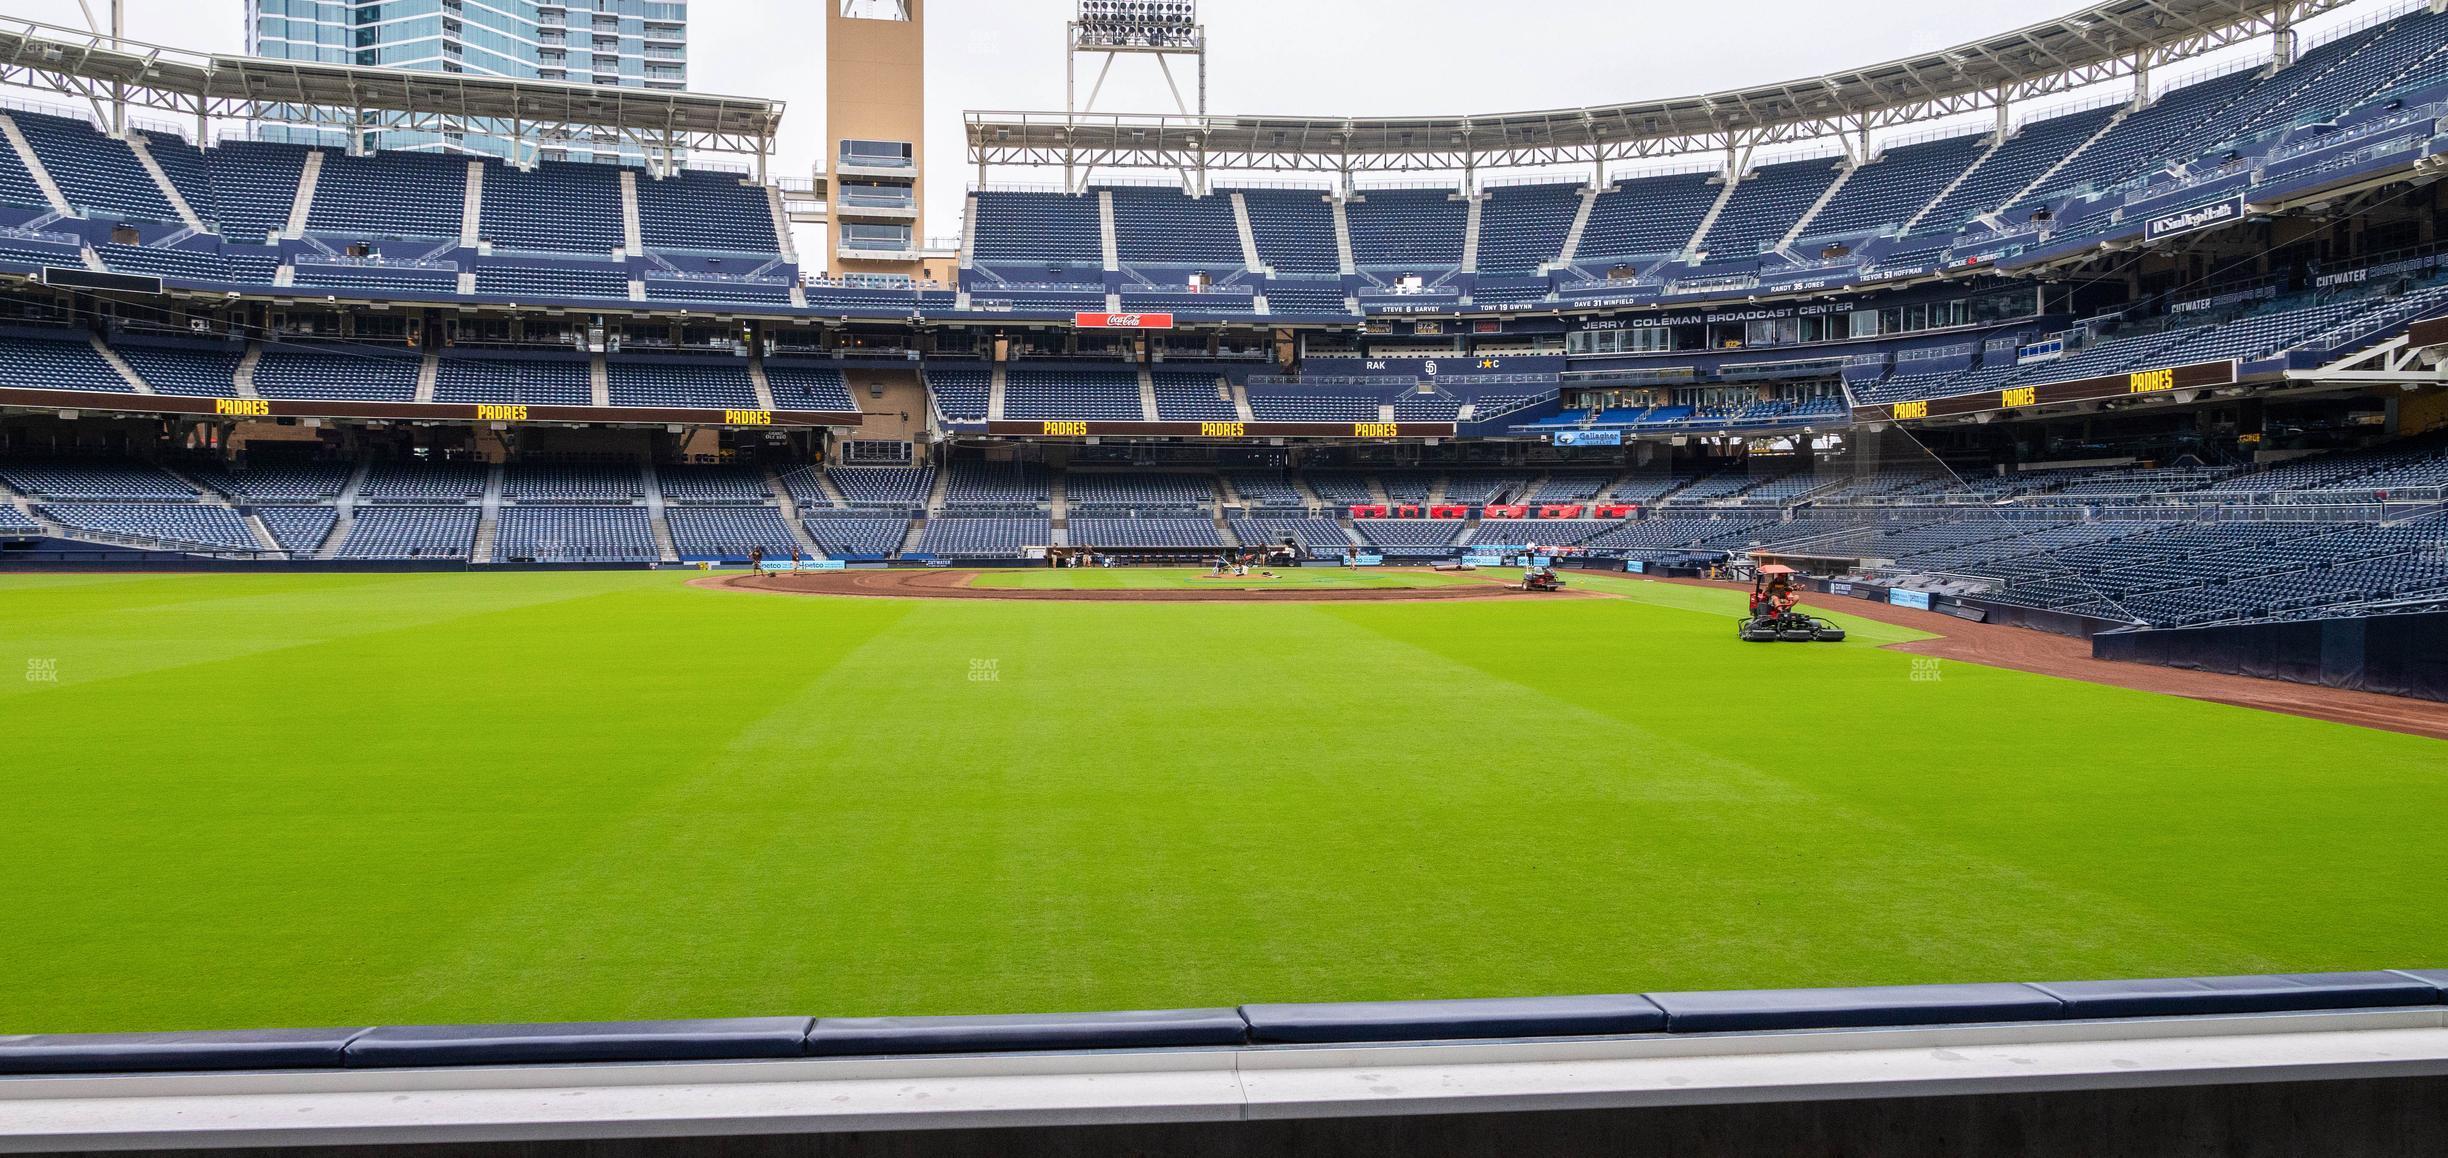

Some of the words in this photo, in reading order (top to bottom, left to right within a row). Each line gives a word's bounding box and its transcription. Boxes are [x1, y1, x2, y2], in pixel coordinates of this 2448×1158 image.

[1860, 273, 1883, 282] TREVOR
[1884, 270, 1893, 279] 51
[1893, 267, 1922, 277] HOFFMAN
[2316, 269, 2366, 287] CUTWATER
[1771, 285, 1792, 293] RANDY
[1793, 283, 1804, 291] 35
[1804, 281, 1824, 289] JONES
[1603, 298, 1634, 306] WINFIELD
[2171, 298, 2211, 313] CUTWATER
[1582, 320, 1625, 330] JERRY
[1633, 315, 1701, 328] COLEMAN
[1707, 308, 1793, 323] BROADCAST
[1799, 302, 1854, 315] CENTER
[1366, 361, 1386, 370] RAK
[2131, 369, 2173, 393] PADRES
[2002, 387, 2035, 407] PADRES
[216, 399, 269, 415] PADRES
[478, 404, 527, 420] PADRES
[1893, 401, 1927, 419] PADRES
[726, 409, 771, 424] PADRES
[1044, 421, 1087, 436] PADRES
[1201, 422, 1244, 436] PADRES
[1355, 423, 1397, 437] PADRES
[1578, 432, 1618, 442] Gallagher
